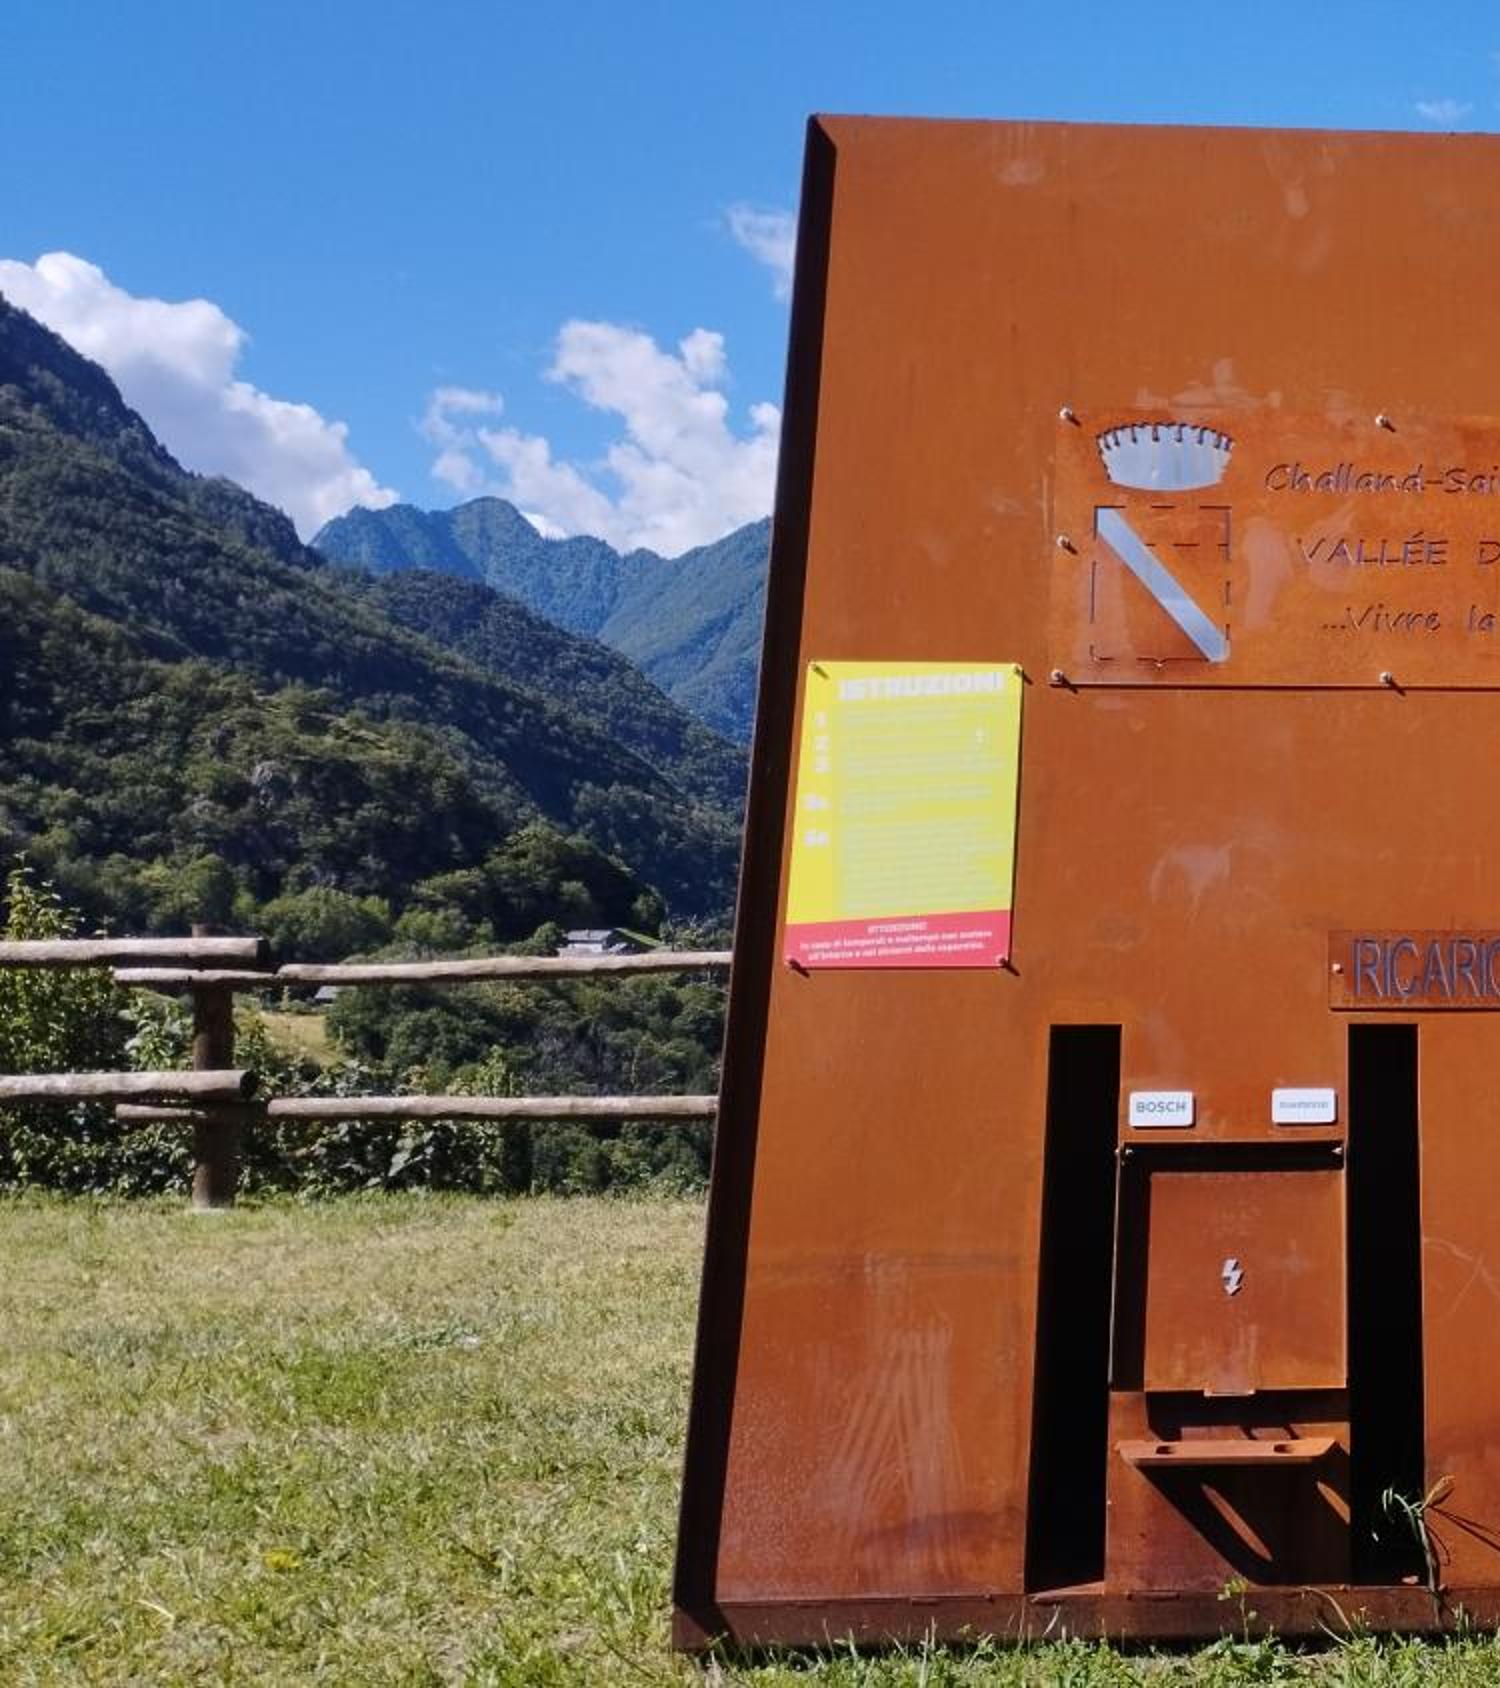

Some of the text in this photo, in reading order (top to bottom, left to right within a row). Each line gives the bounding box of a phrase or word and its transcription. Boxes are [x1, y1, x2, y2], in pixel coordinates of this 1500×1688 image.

[1297, 531, 1449, 566] VALLÉE
[1468, 604, 1496, 633] la
[1136, 1100, 1186, 1113] BOSCH
